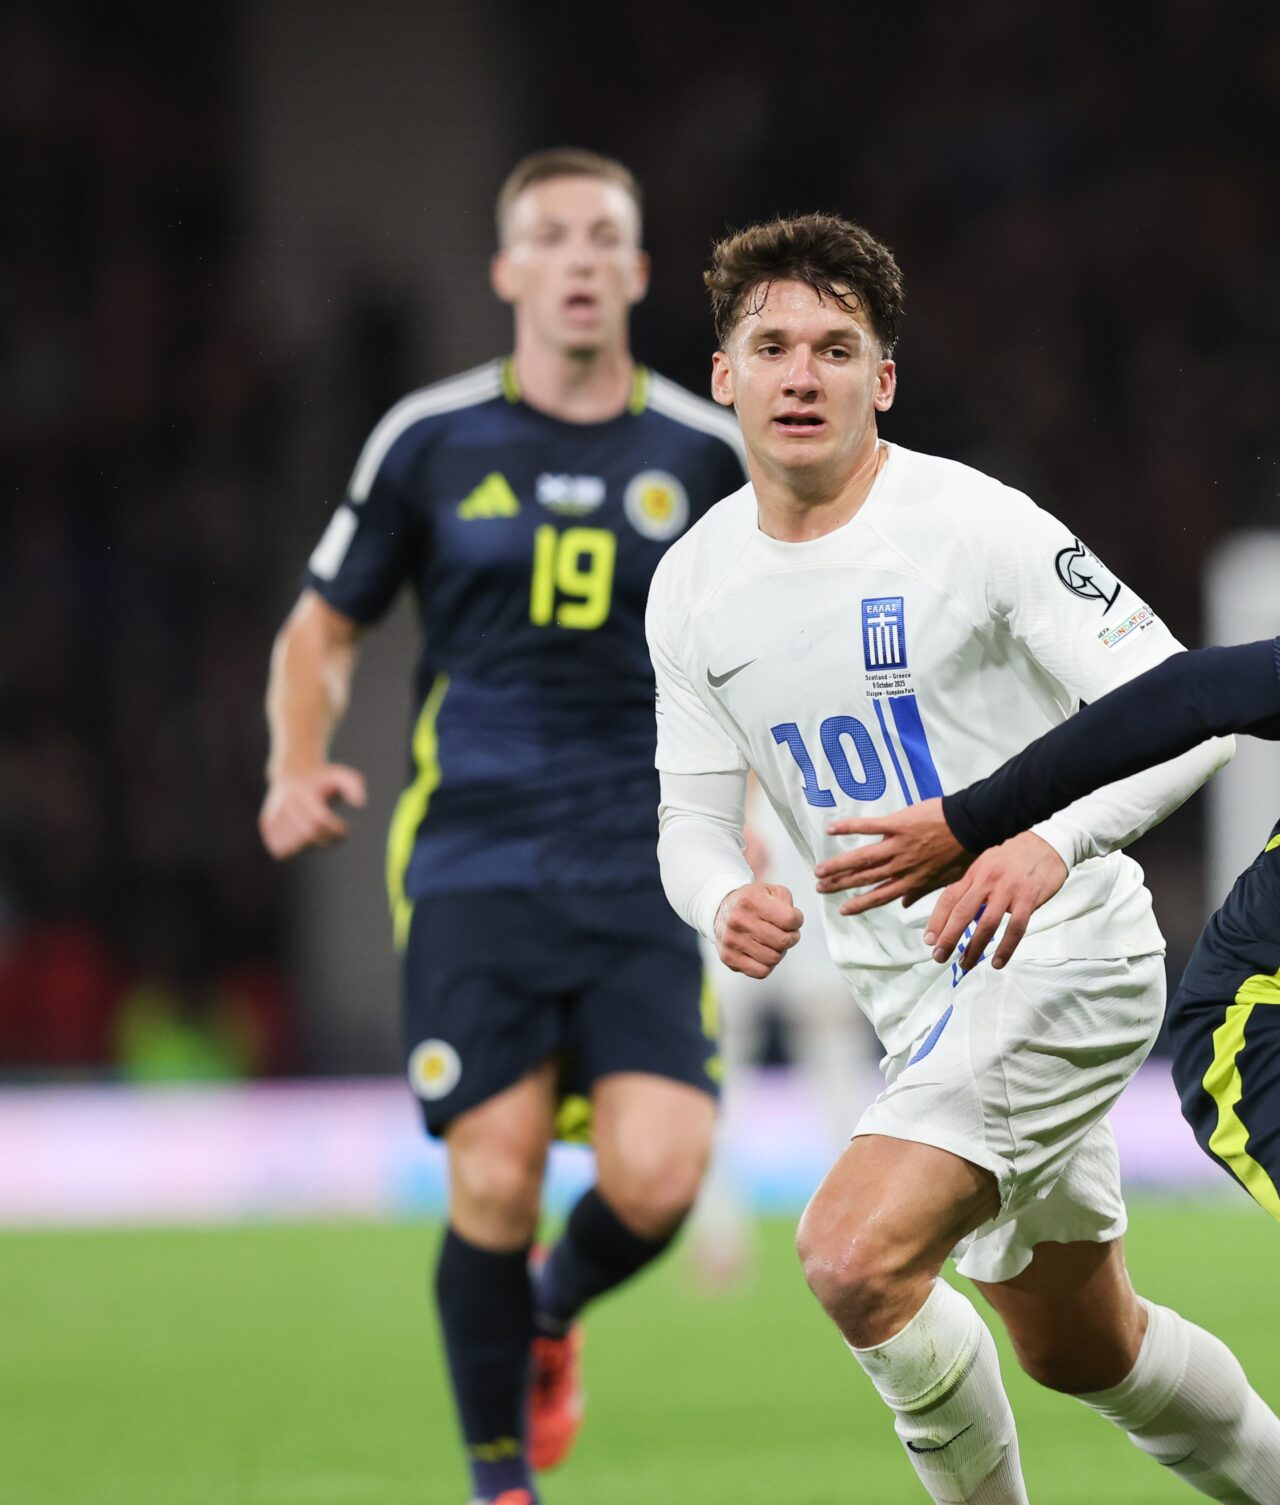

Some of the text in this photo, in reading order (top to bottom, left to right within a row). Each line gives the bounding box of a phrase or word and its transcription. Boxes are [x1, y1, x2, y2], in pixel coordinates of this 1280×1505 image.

[529, 524, 617, 630] 19
[1103, 611, 1146, 646] FOUNDATIO
[894, 680, 906, 688] 2025
[770, 715, 887, 808] 10
